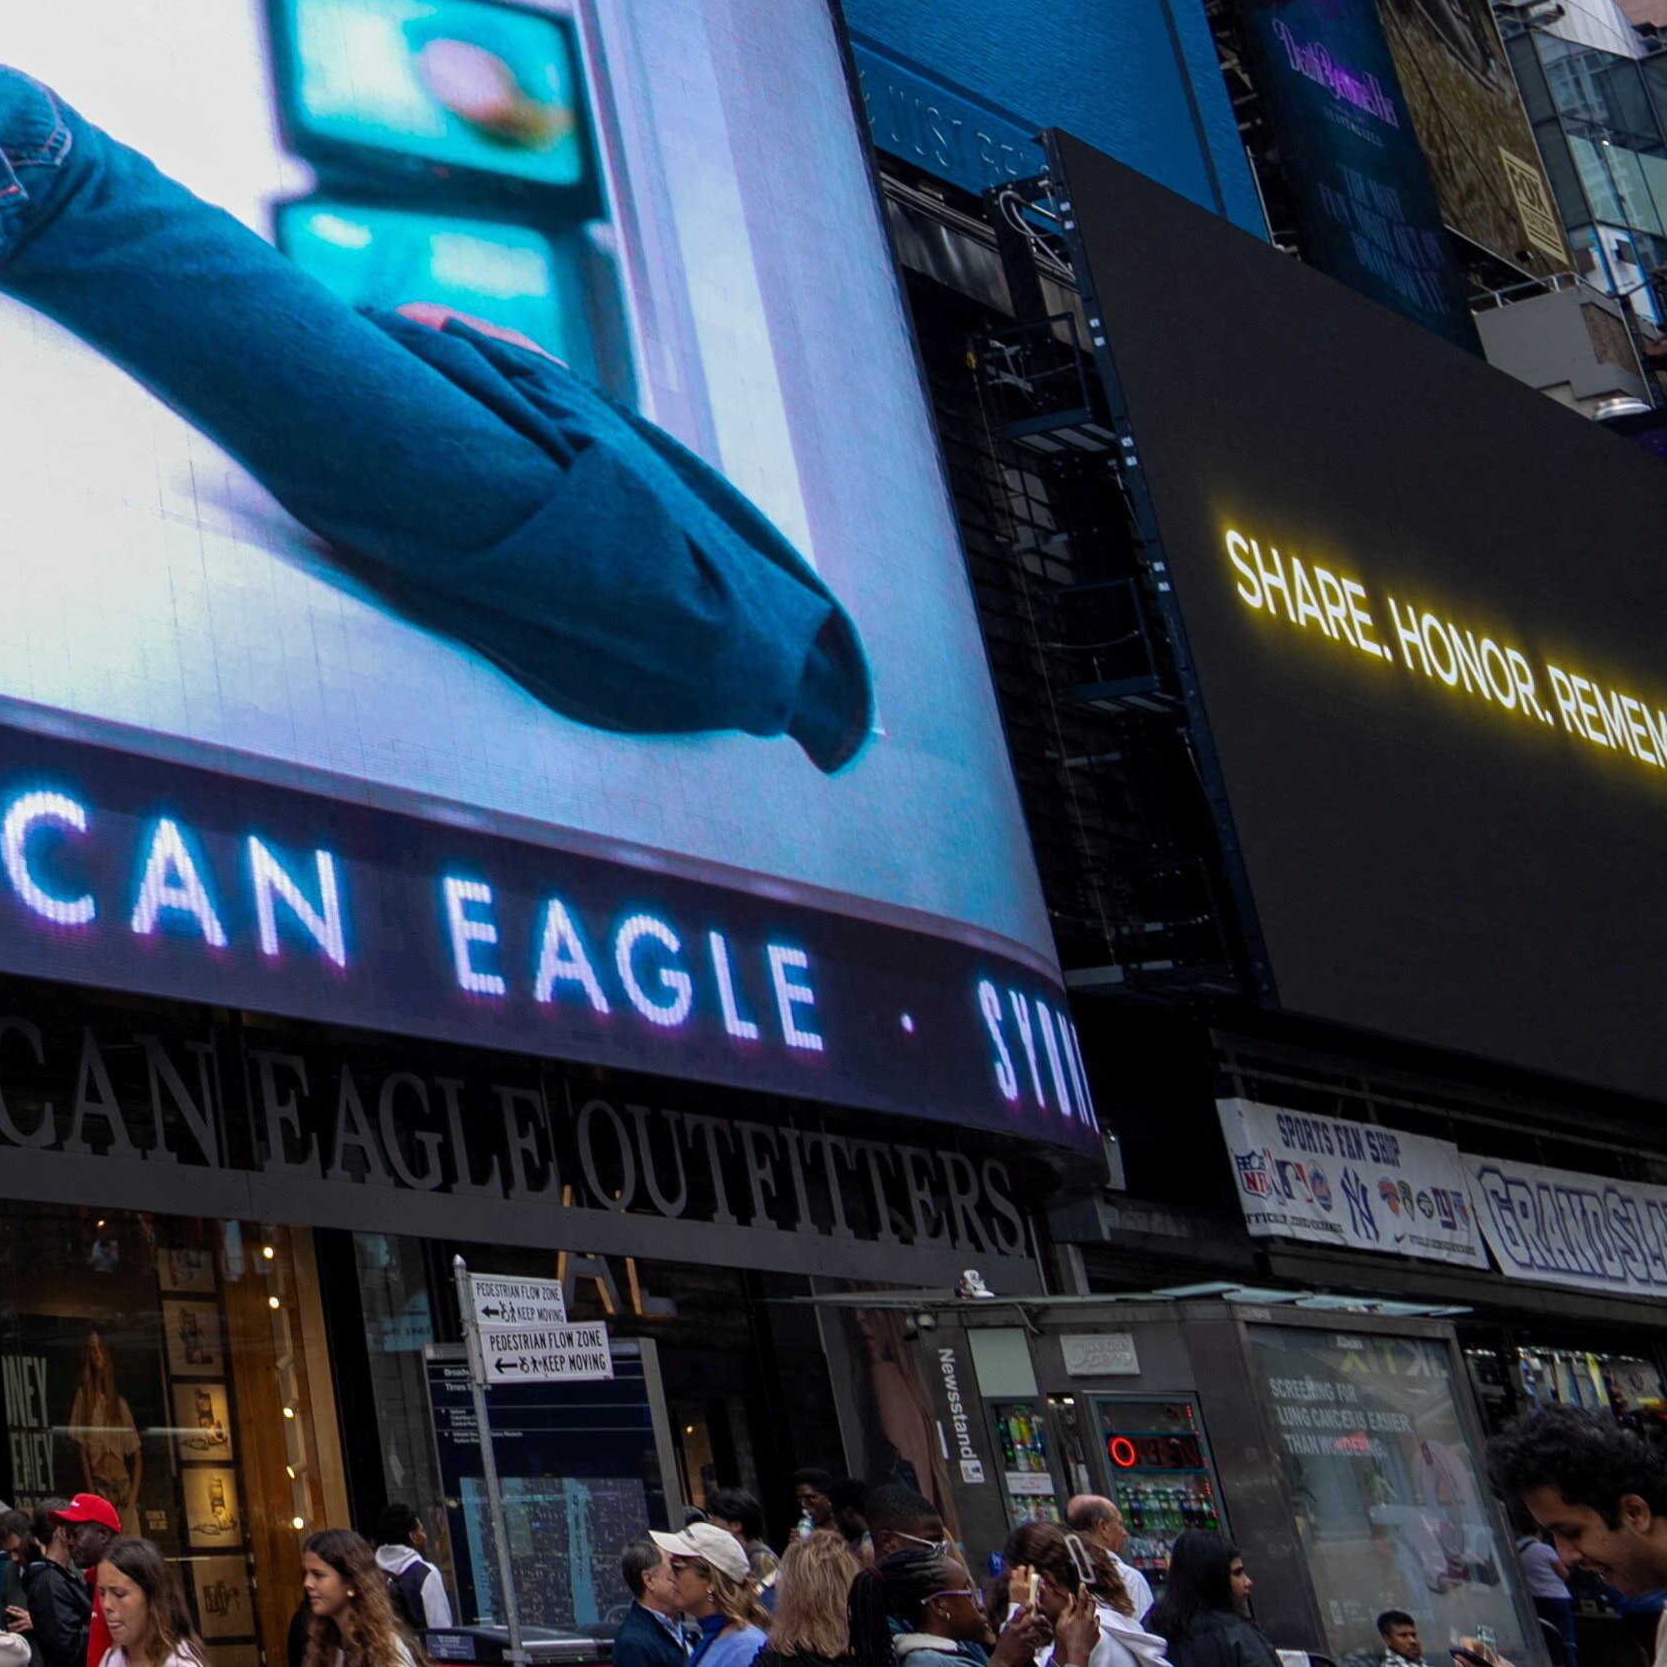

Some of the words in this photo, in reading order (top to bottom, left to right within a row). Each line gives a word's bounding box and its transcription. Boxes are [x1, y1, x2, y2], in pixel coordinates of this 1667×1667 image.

[1225, 529, 1394, 662] SHARE.
[1388, 596, 1554, 726] HONOR.
[443, 875, 824, 1052] EAGLE
[248, 1048, 560, 1201] EAGLE
[576, 1098, 1027, 1260] OUTFITTERS
[1275, 1112, 1336, 1157] SPORTS
[1332, 1123, 1369, 1163] FAN
[1366, 1129, 1402, 1168] SHOP
[476, 1282, 518, 1298] PEDESTRIAN
[521, 1285, 541, 1300] FLOW
[542, 1287, 560, 1302] ZONE
[517, 1306, 535, 1322] KEEP
[538, 1308, 564, 1323] MOVING
[490, 1333, 546, 1352] PEDESTRIAN
[549, 1331, 573, 1349] FLOW
[577, 1330, 603, 1348] ZONE
[542, 1357, 565, 1373] KEEP
[569, 1354, 606, 1372] MOVING
[937, 1347, 979, 1461] Newsstand
[1269, 1377, 1335, 1402] SCREENING
[1336, 1382, 1358, 1403] FOR
[1276, 1405, 1311, 1428] LUNG
[1311, 1408, 1355, 1430] CANCER
[1355, 1411, 1366, 1430] IS
[1368, 1412, 1413, 1433] EASIER
[1283, 1433, 1319, 1455] THAN
[11, 1433, 55, 1491] ENEY
